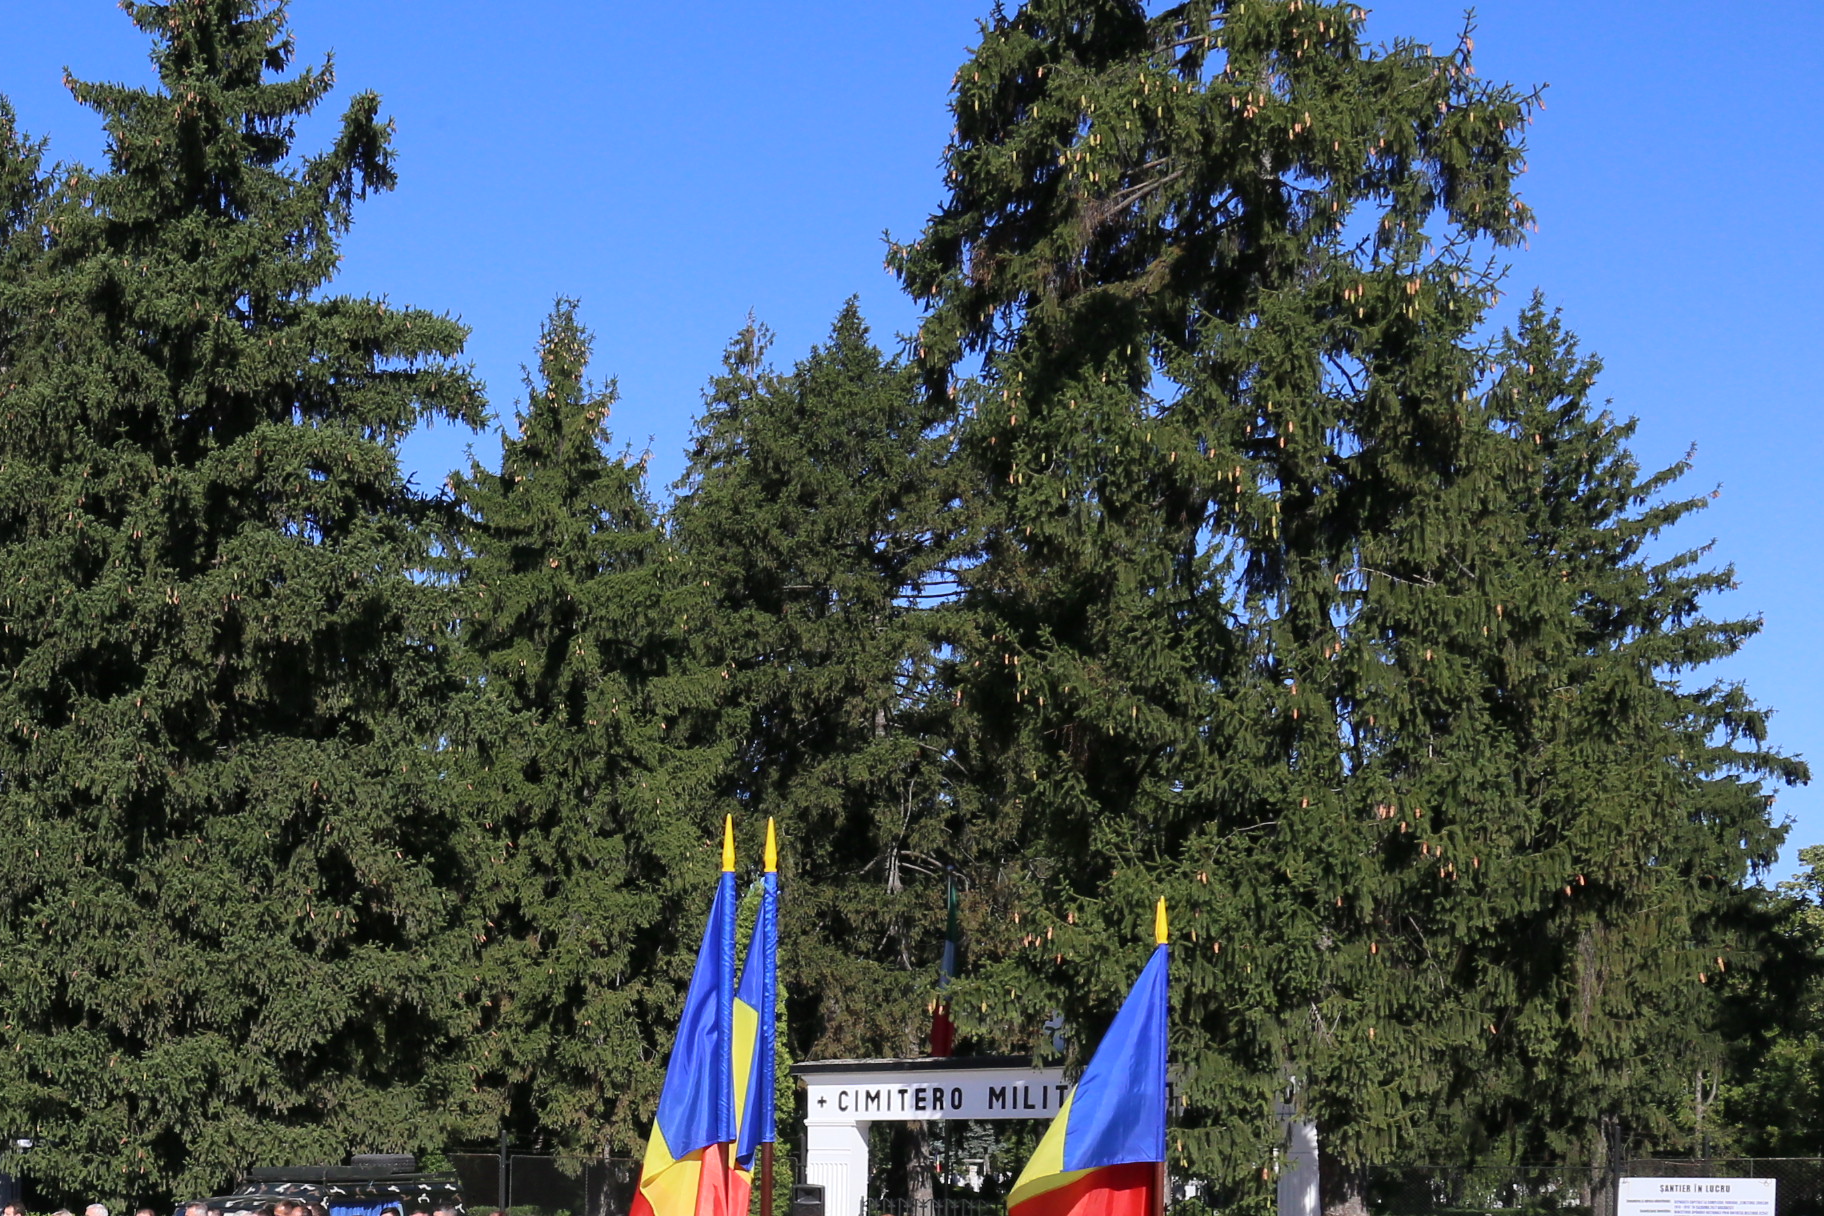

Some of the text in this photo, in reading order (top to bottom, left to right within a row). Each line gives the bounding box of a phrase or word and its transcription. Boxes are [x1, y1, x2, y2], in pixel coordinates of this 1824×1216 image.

[838, 1085, 1068, 1112] CIMITERO MILIT
[1706, 1184, 1731, 1193] LUCRU
